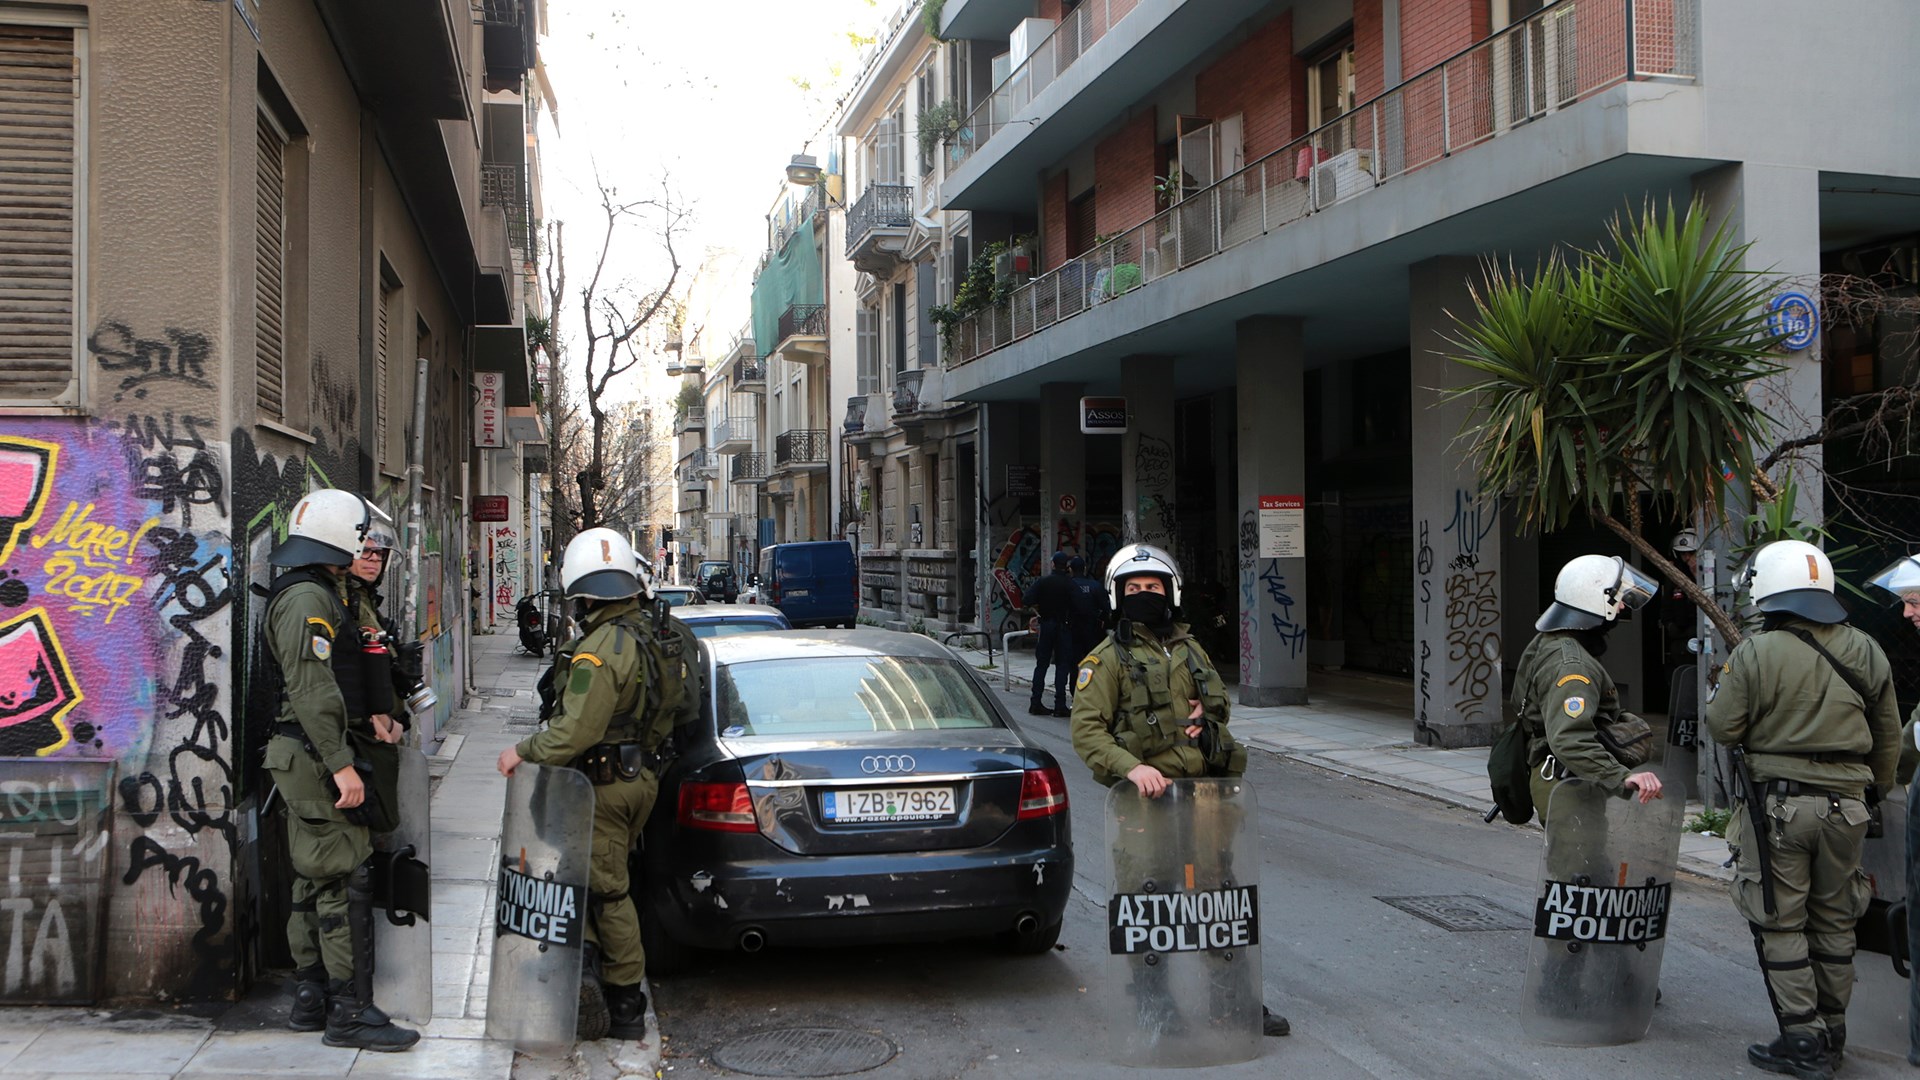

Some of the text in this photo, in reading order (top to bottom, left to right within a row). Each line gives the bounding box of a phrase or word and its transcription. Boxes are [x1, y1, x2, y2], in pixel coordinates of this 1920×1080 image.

[501, 869, 576, 919] ΤΥΝΟΜΙΑ
[1117, 888, 1253, 927] ΑΣΤΥΝΟΜΙΑ
[1544, 883, 1666, 918] ΑΣΤΥΝΟΜΙΑ
[500, 900, 568, 944] OLICE
[1125, 919, 1249, 952] POLICE
[1548, 912, 1660, 942] POLICE
